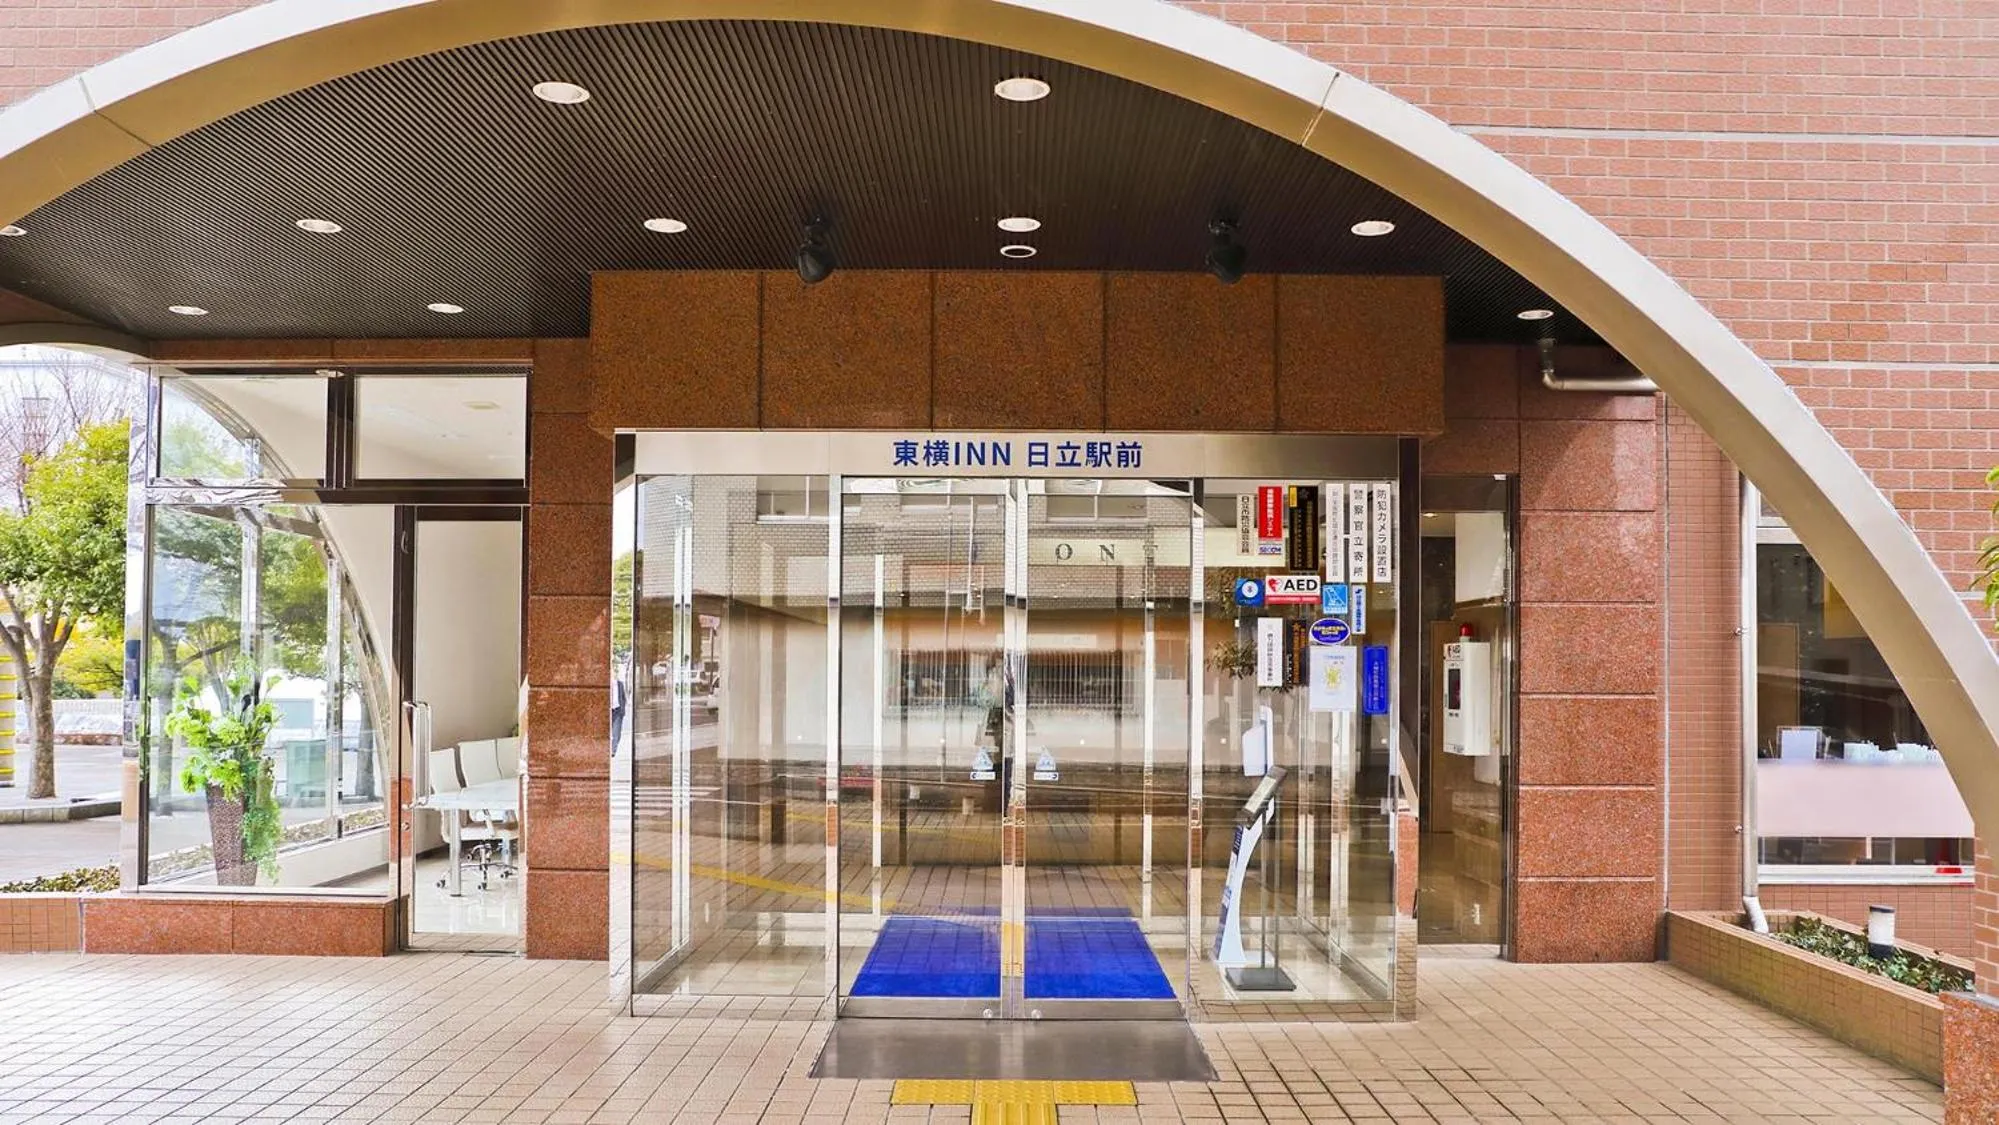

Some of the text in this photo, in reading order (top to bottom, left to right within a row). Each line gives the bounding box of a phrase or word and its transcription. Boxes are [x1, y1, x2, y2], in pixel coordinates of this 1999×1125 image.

[893, 440, 1142, 468] 東横INN 日立駅前
[1353, 489, 1364, 577] 警察官立寄所
[1376, 489, 1387, 577] 防犯カメラ設置店
[1284, 579, 1318, 591] AED
